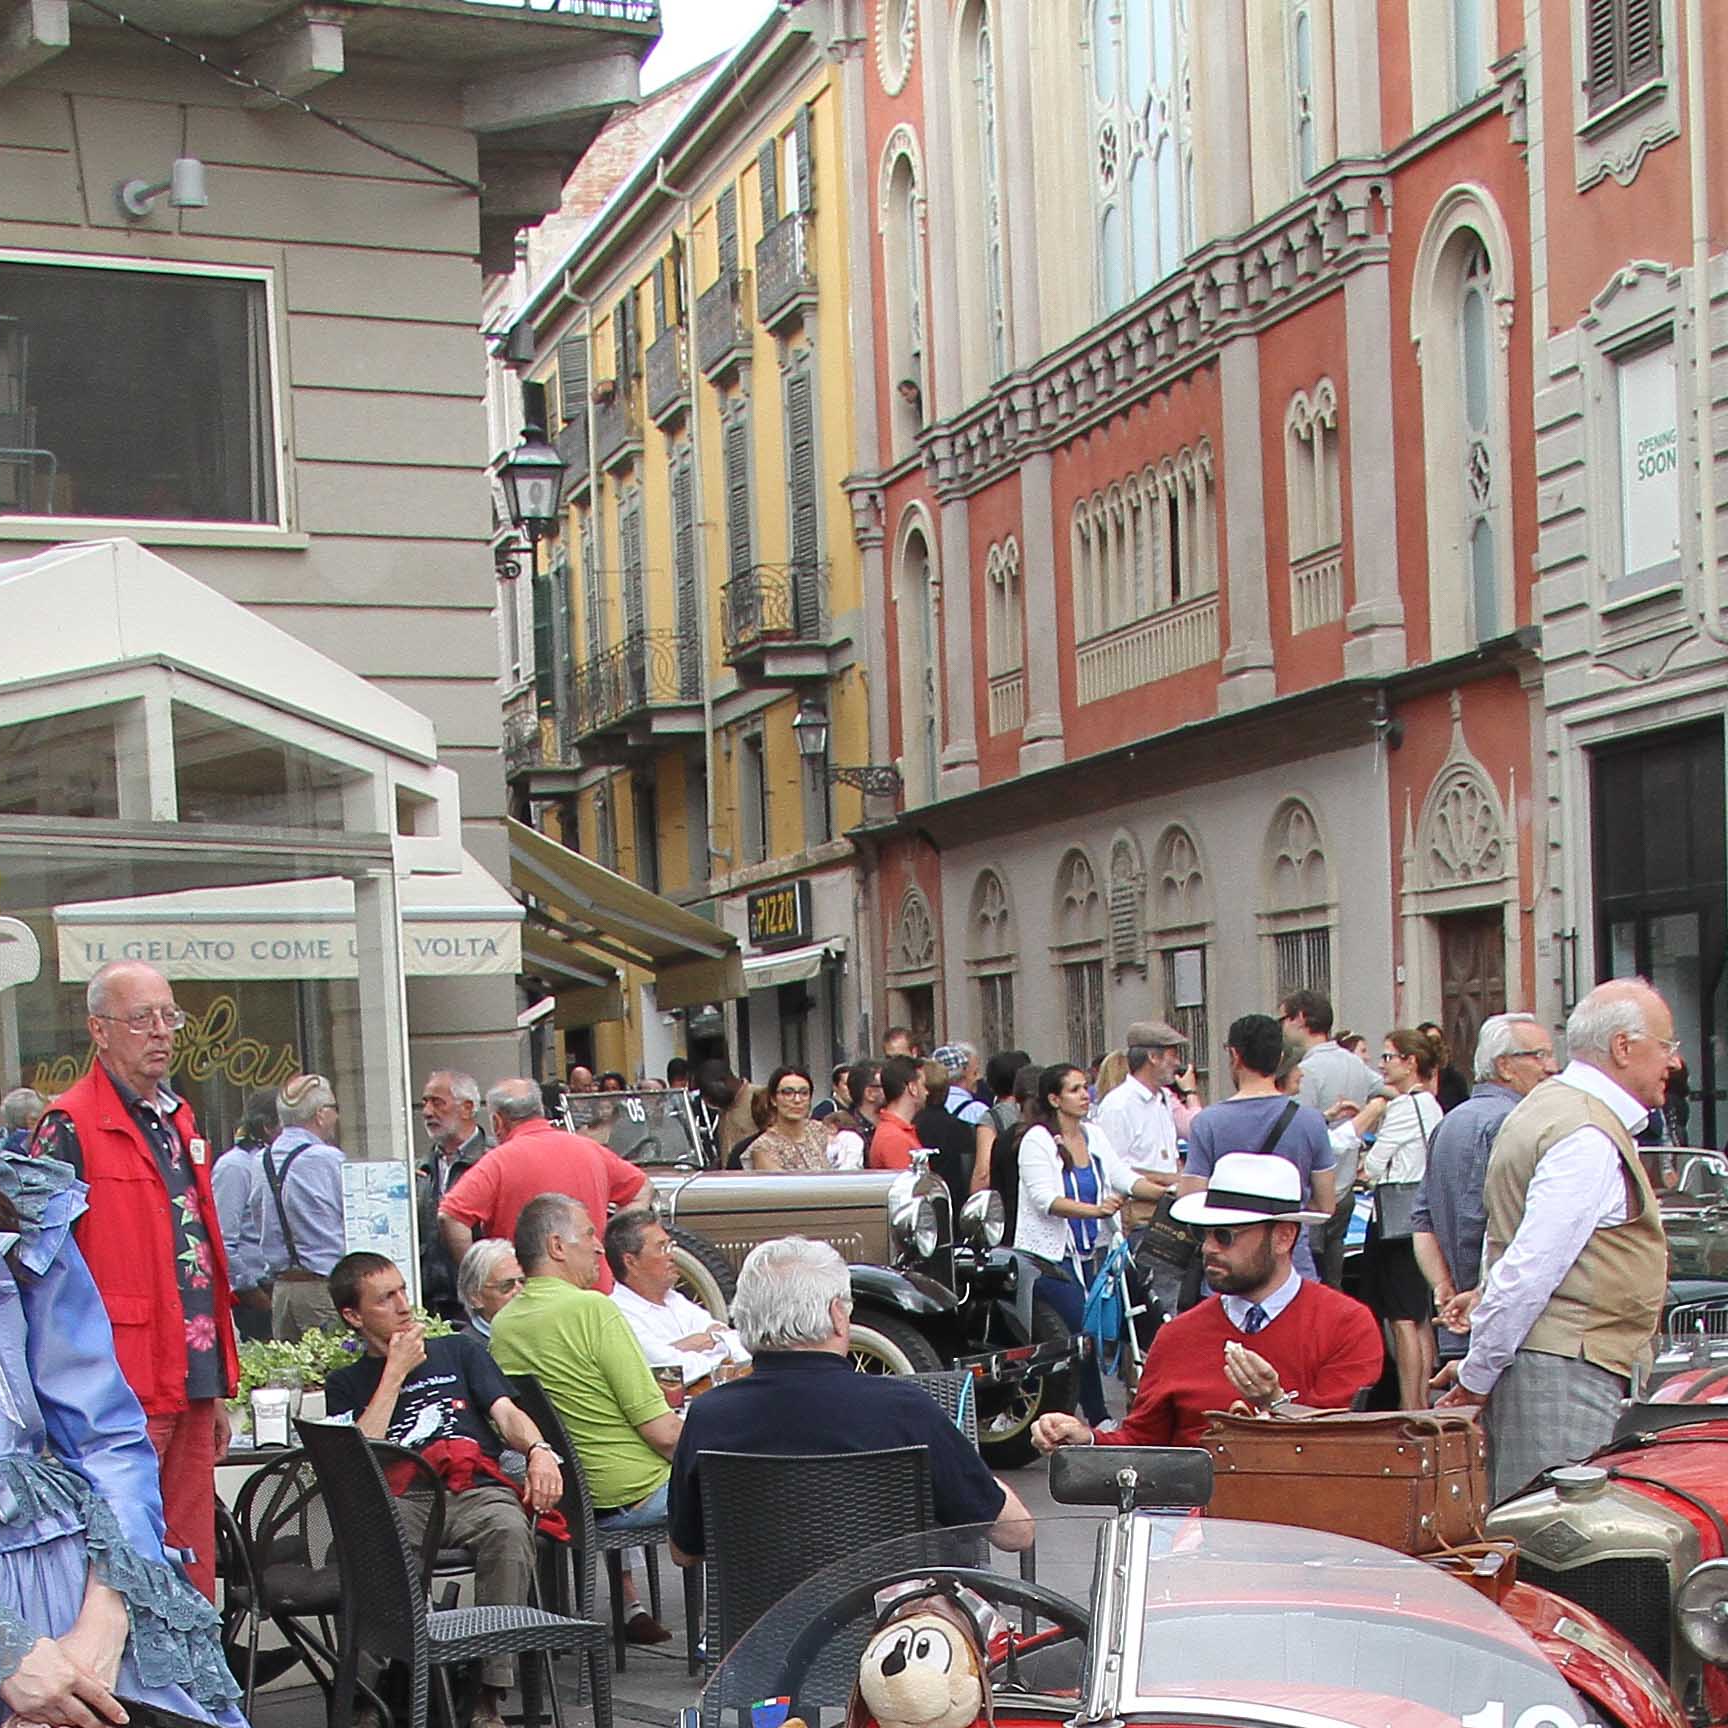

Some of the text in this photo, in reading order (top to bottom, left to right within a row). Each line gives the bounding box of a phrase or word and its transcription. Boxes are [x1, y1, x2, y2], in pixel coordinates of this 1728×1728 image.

[1637, 427, 1677, 456] OPENING
[1637, 448, 1677, 480] SOON
[84, 943, 110, 962] IL
[122, 940, 236, 962] GELATO
[250, 939, 333, 961] COME
[415, 937, 499, 958] VOLTA
[627, 1097, 646, 1122] 05
